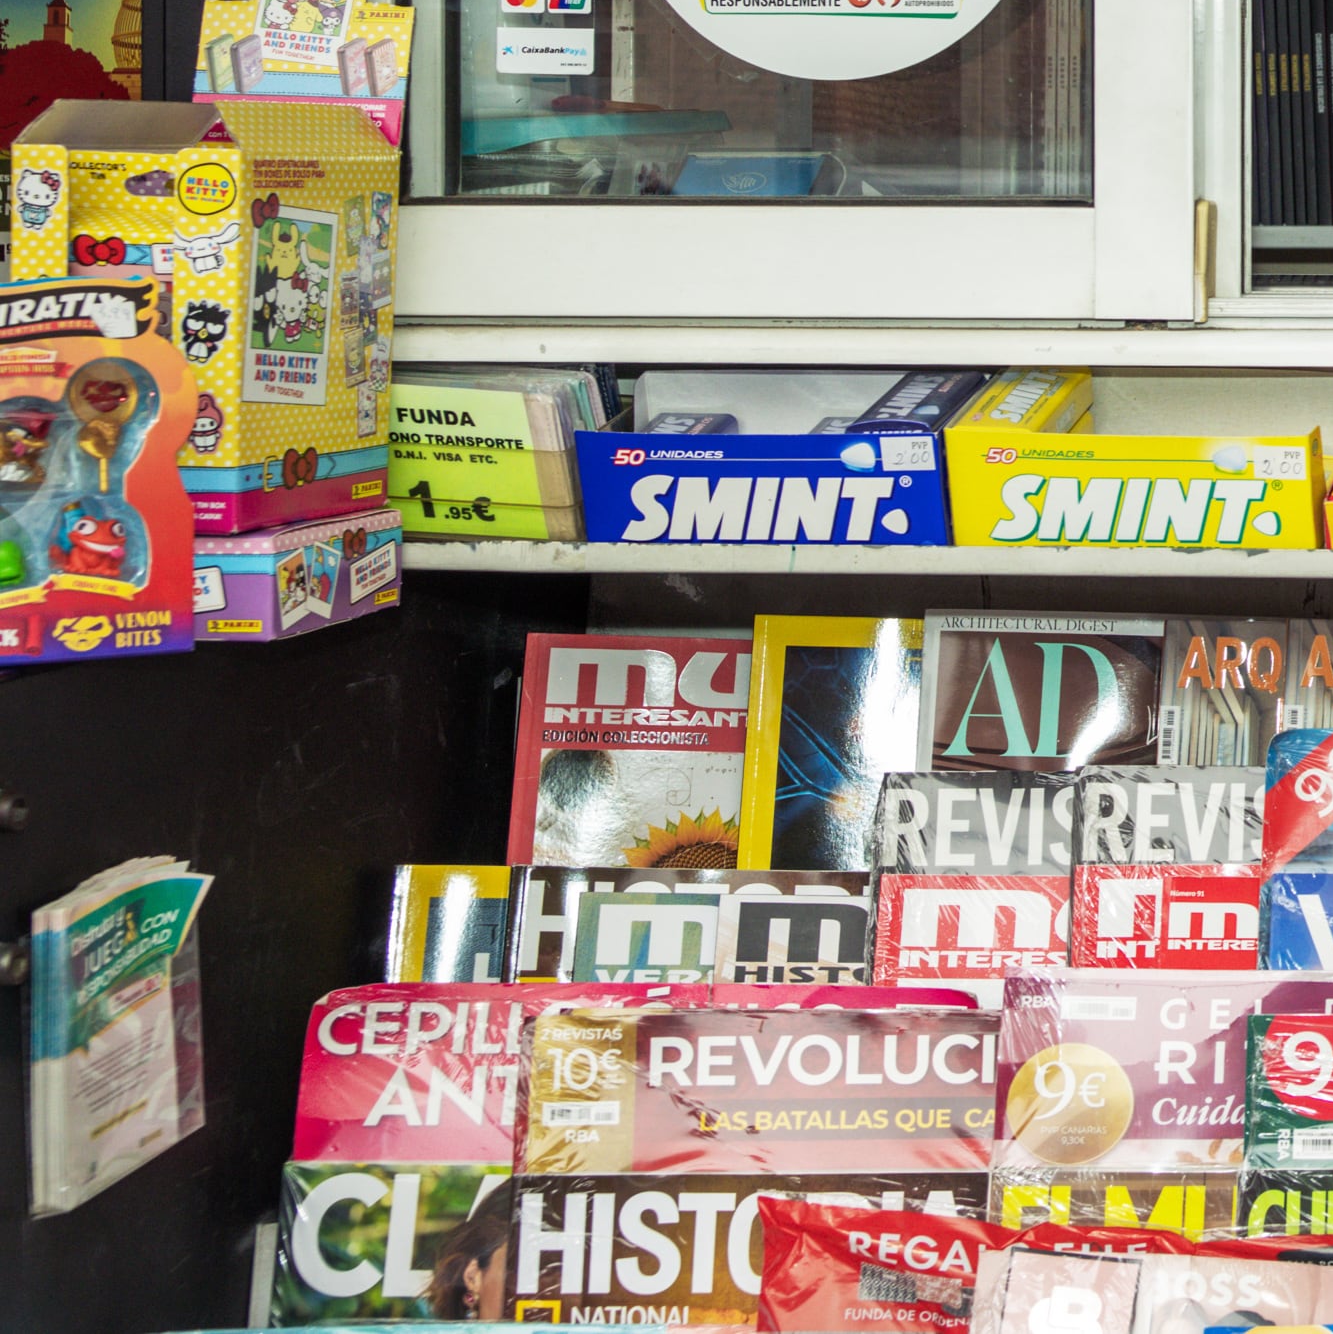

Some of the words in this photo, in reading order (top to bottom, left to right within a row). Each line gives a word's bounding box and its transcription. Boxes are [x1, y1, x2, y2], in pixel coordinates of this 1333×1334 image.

[396, 407, 477, 427] FUNDA
[424, 433, 525, 451] TRANSPORTE
[394, 449, 427, 461] D.N.I.
[433, 451, 463, 463] VISA
[614, 447, 645, 467] 50
[649, 449, 725, 460] UNIDADES
[115, 611, 172, 629] VENOM
[940, 616, 1059, 632] ARCHITECTURAL
[1064, 619, 1117, 632] DIGEST
[116, 629, 162, 649] BITES
[941, 637, 1123, 758] AD
[698, 1110, 750, 1132] LAS
[755, 1110, 888, 1131] BATALLAS
[894, 1108, 951, 1130] QUE
